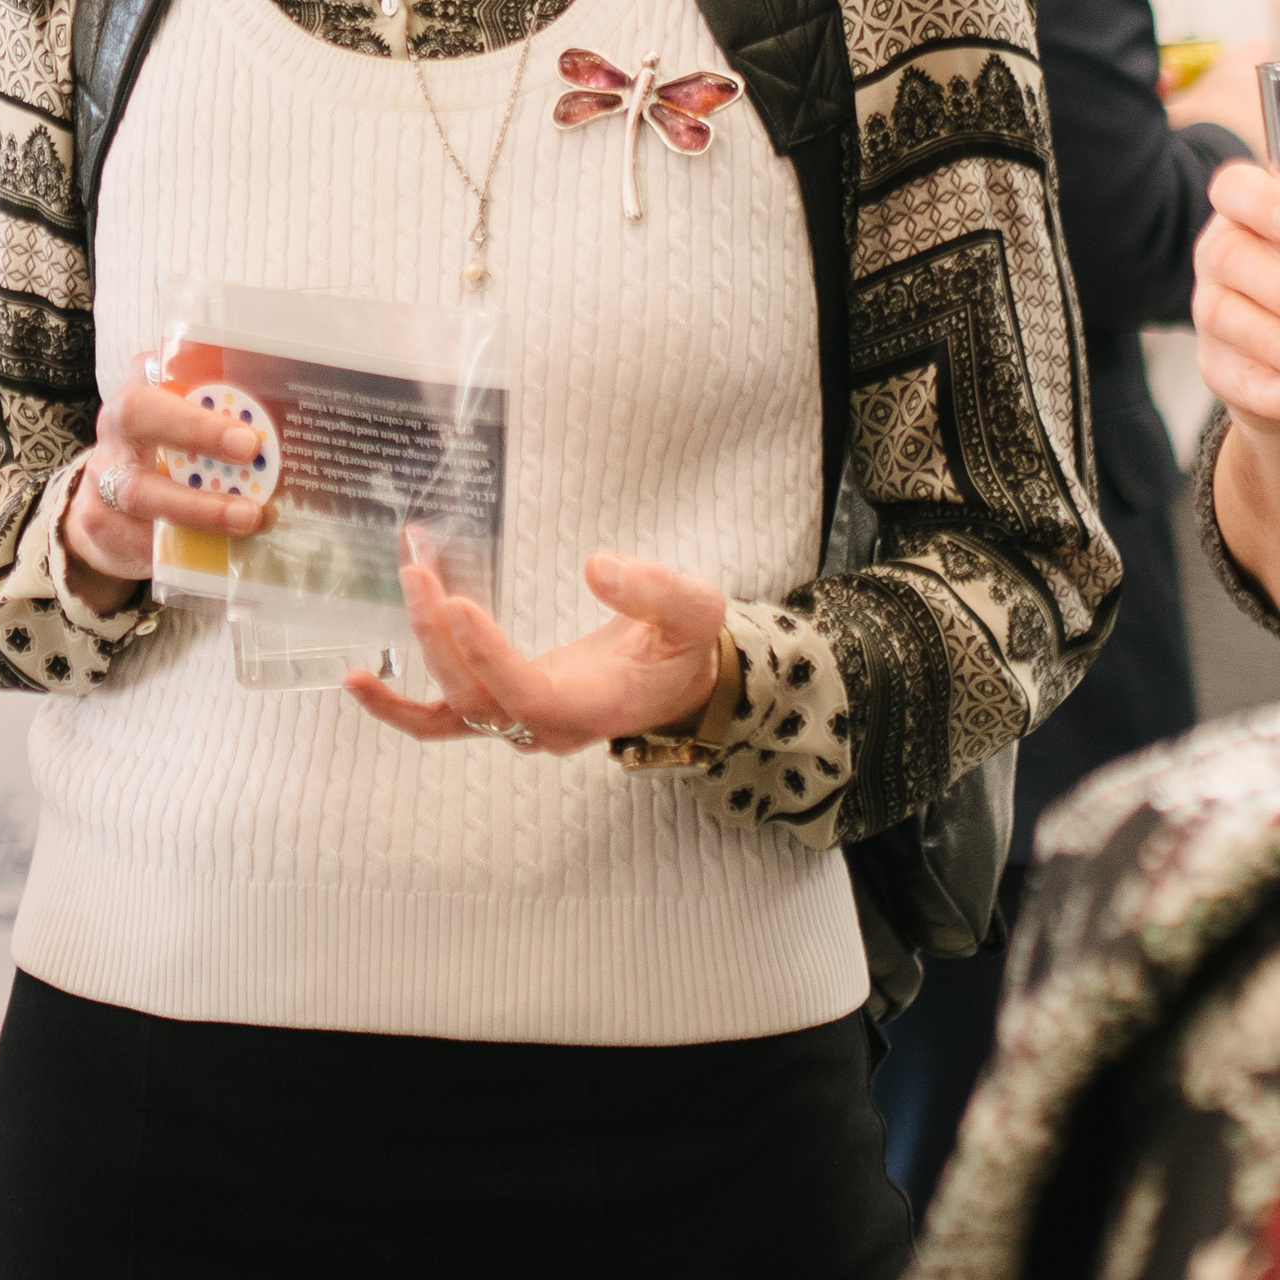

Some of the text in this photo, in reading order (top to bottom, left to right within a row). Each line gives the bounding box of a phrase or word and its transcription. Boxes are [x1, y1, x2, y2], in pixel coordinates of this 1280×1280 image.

[298, 401, 328, 415] visual
[353, 392, 397, 411] diversity
[334, 407, 372, 423] become
[372, 413, 404, 429] colors
[404, 418, 422, 432] the
[283, 429, 301, 441] and
[285, 414, 489, 458] approhable. When used together in the
[302, 433, 331, 445] warm
[331, 438, 348, 448] are
[347, 439, 381, 456] yellow
[280, 442, 313, 458] sturdy
[311, 450, 332, 462] and
[381, 447, 401, 460] and
[402, 448, 438, 463] orange
[332, 451, 393, 473] trustworthy
[299, 463, 319, 476] The
[394, 464, 411, 474] are
[412, 467, 432, 480] teal
[284, 476, 295, 486] of
[295, 479, 319, 492] sides
[319, 483, 339, 494] two
[339, 486, 357, 499] the
[463, 506, 486, 518] The
